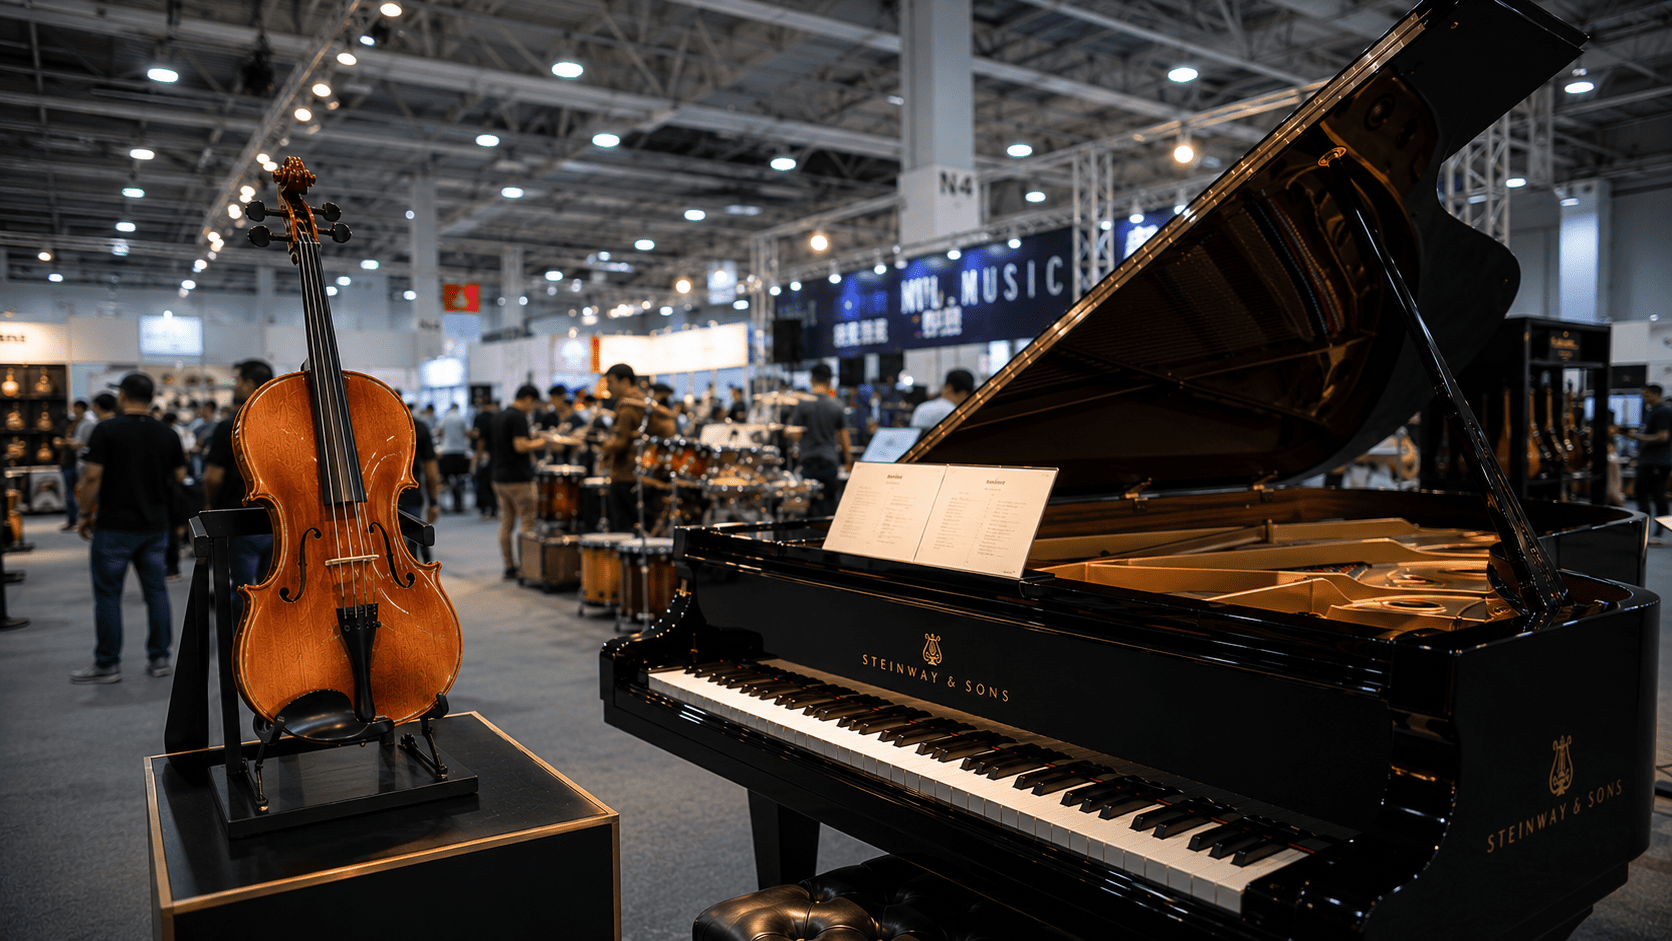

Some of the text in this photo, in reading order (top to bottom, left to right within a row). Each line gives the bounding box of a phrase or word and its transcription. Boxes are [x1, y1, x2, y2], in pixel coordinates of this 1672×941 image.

[940, 171, 973, 196] N4
[862, 654, 1009, 702] STEINWAY & SONS
[1487, 779, 1623, 854] STEINWAY & SONS
